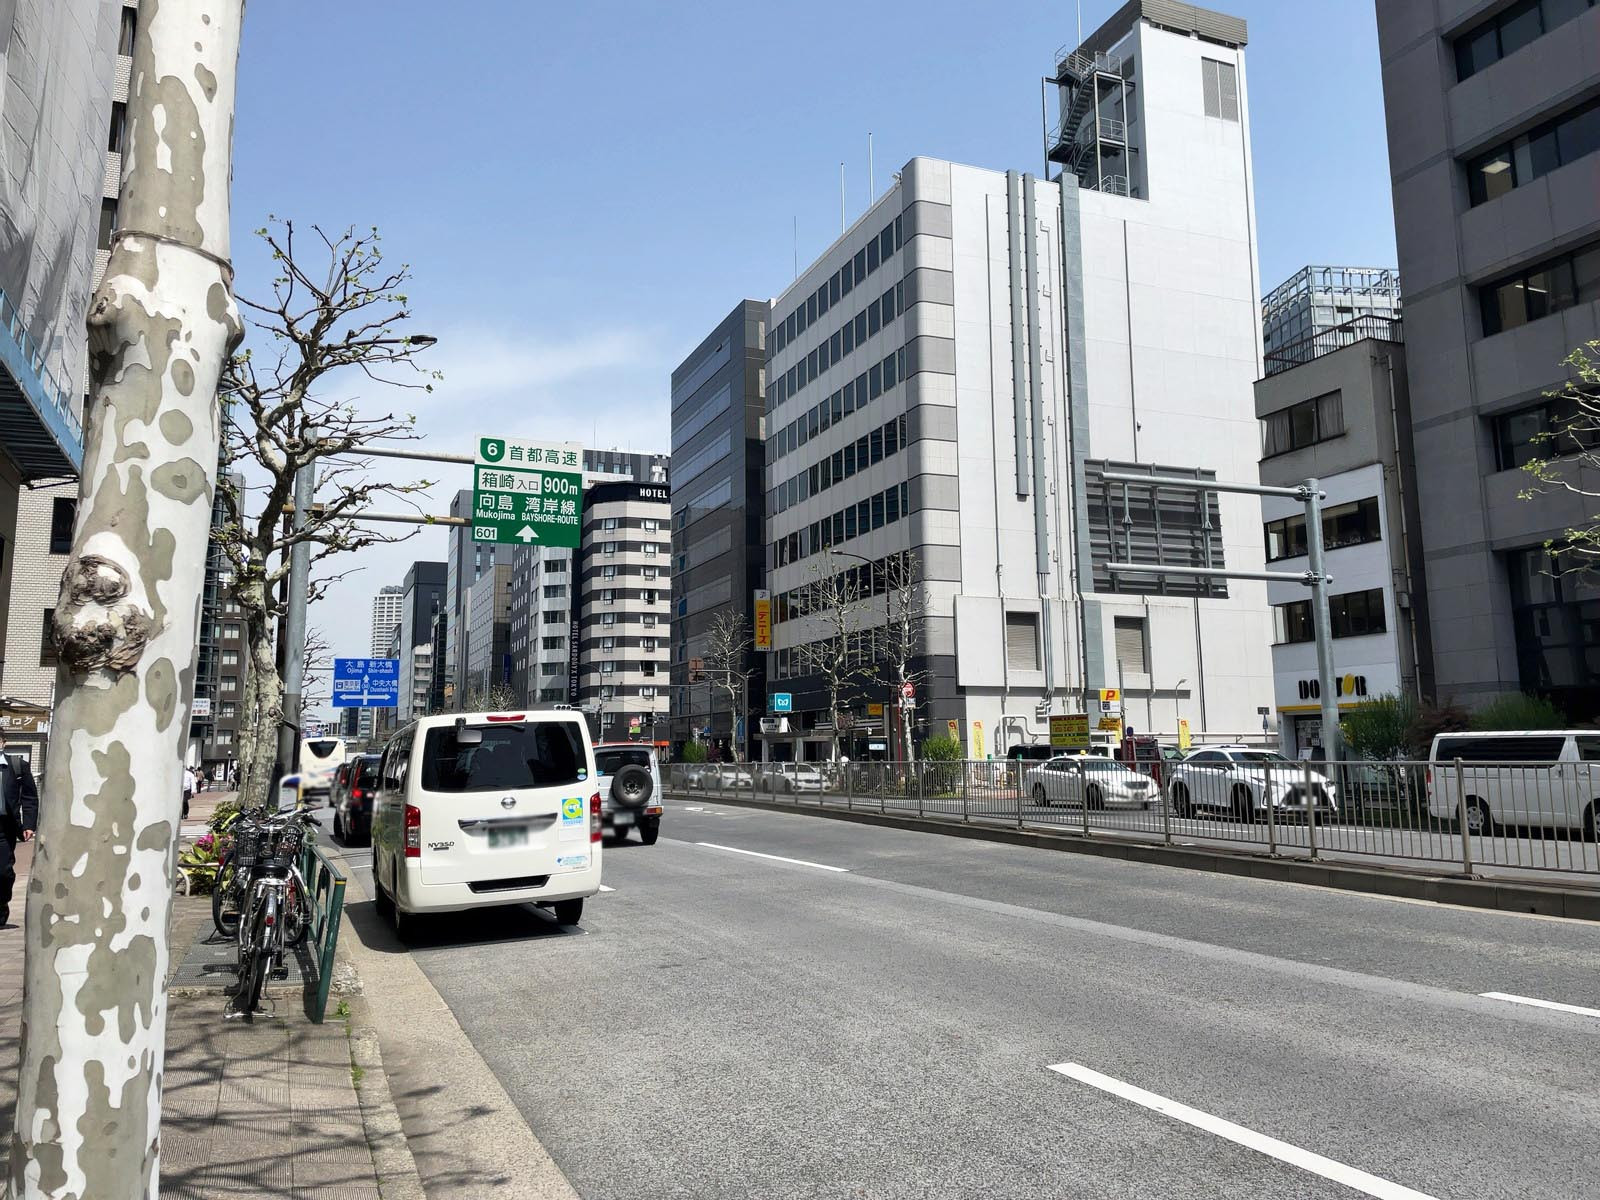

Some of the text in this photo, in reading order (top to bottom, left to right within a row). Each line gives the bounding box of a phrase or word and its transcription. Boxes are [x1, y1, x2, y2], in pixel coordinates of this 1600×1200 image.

[487, 442, 498, 456] 6
[508, 446, 577, 467] 首都高速
[481, 472, 578, 496] 箱崎入口 900m
[639, 488, 668, 499] HOTEL
[480, 493, 576, 516] 向島 湾岸線
[476, 508, 579, 525] Mukojima BAYSHORE-ROUTE
[475, 527, 496, 539] 601
[1298, 672, 1367, 699] DOTOR
[1106, 690, 1115, 700] P
